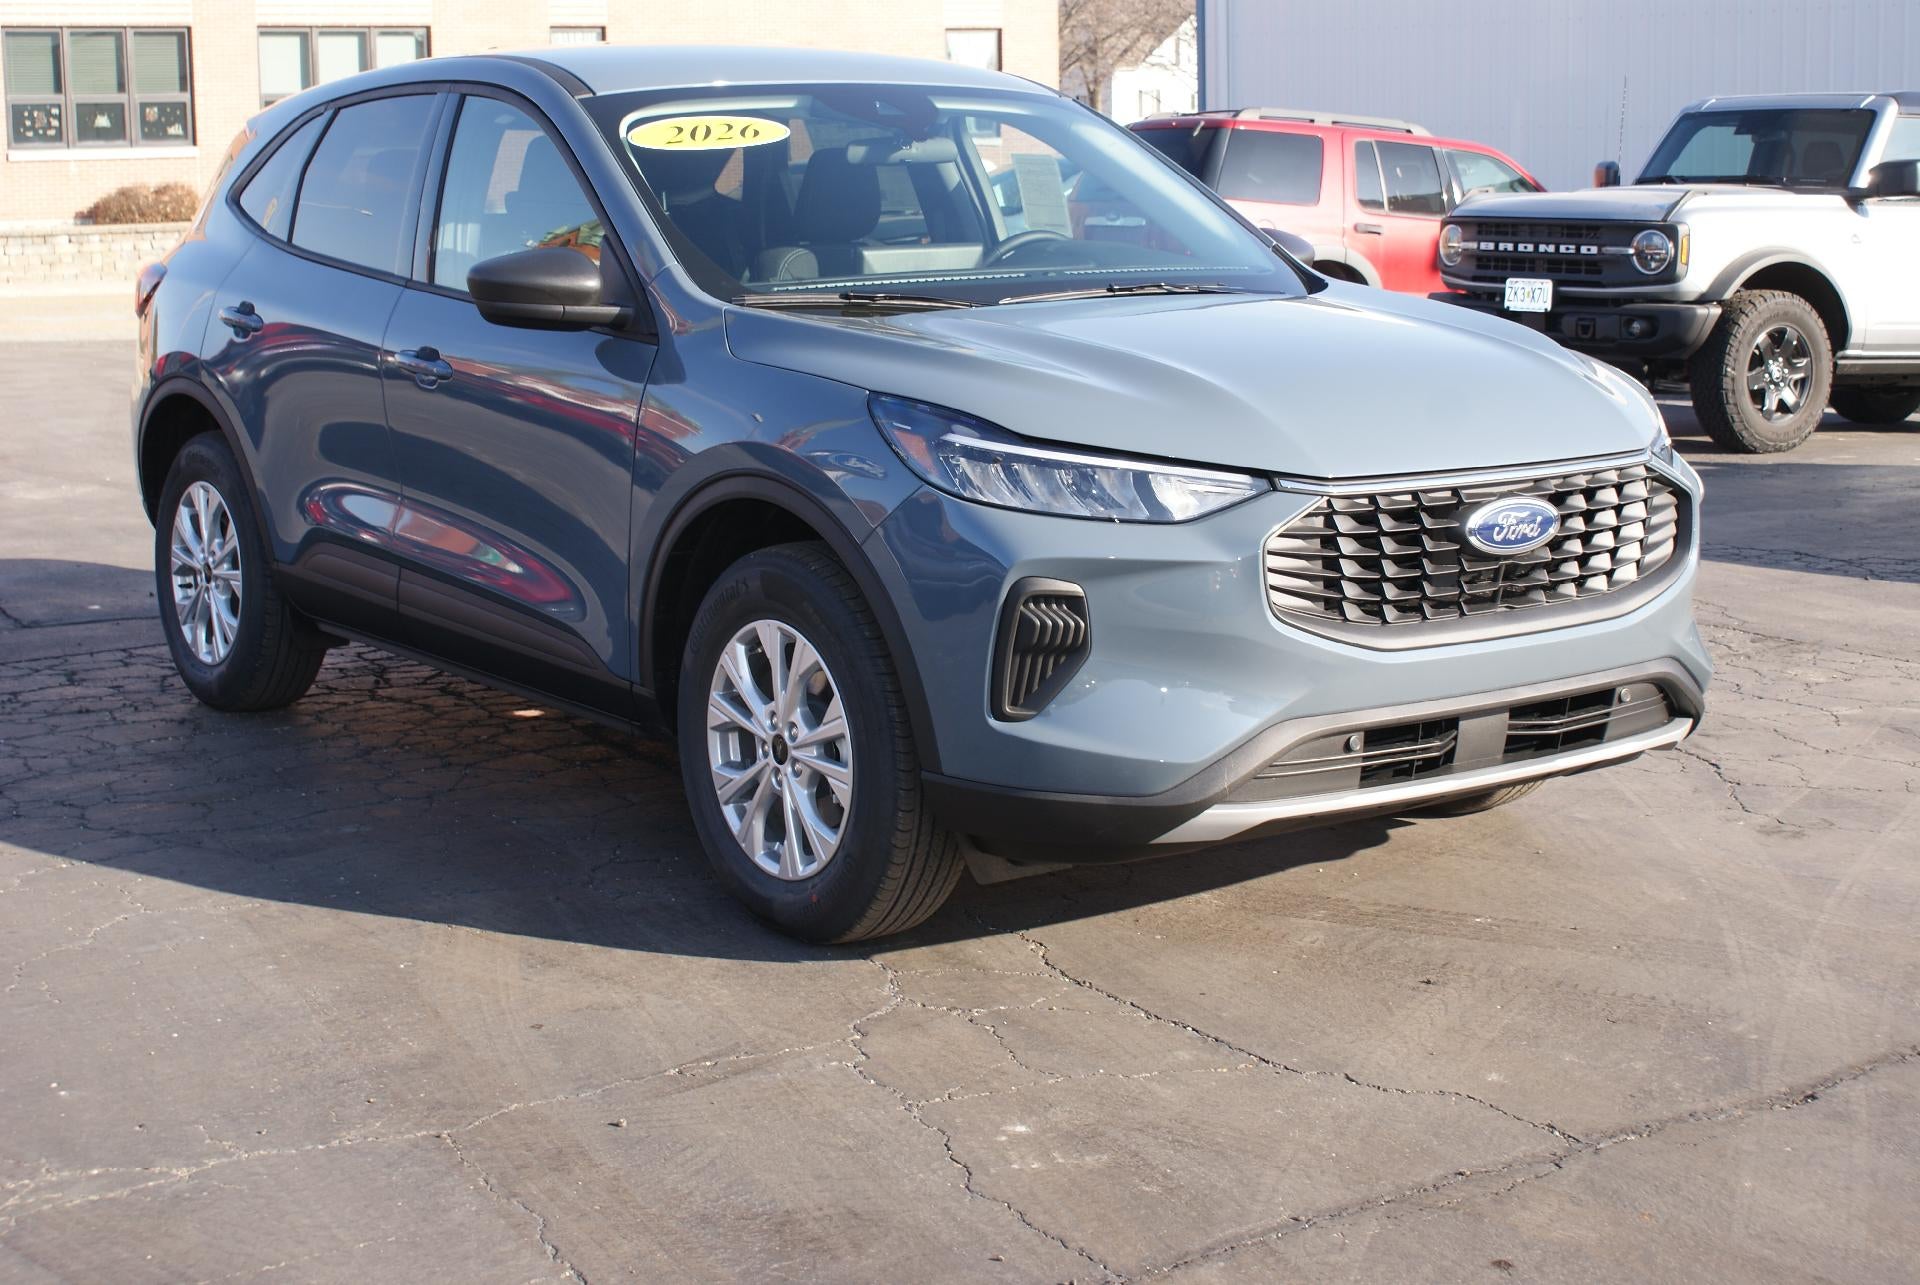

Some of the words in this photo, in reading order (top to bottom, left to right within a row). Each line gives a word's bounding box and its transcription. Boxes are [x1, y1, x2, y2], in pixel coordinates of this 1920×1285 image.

[665, 123, 760, 145] 2026
[1479, 241, 1598, 254] BRONCO
[1493, 511, 1543, 542] Ford
